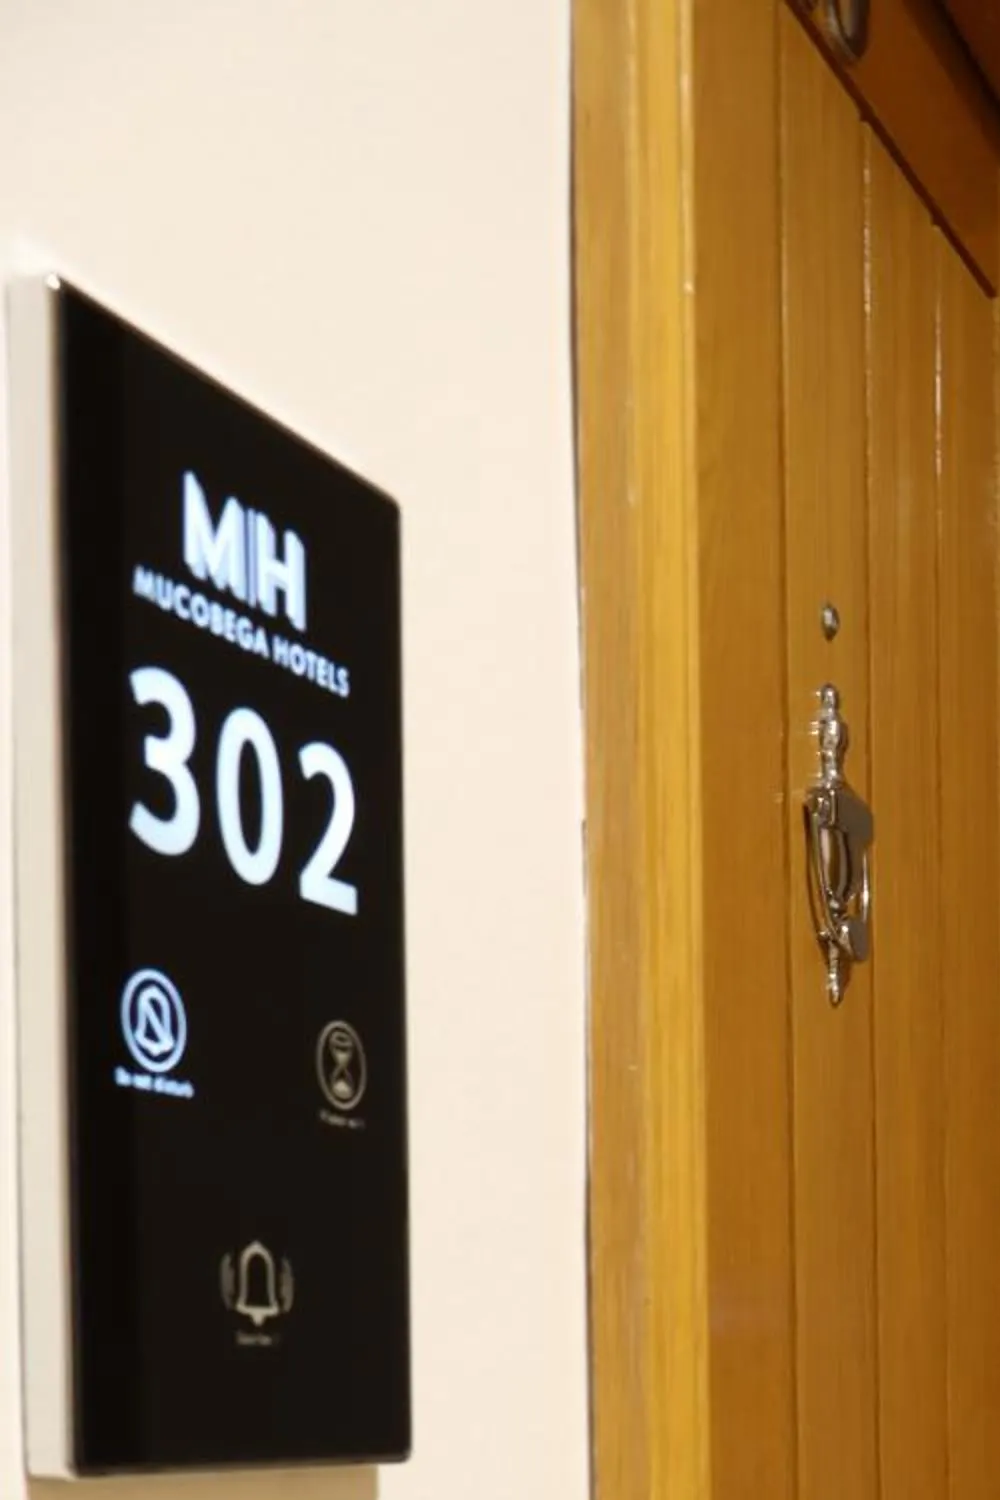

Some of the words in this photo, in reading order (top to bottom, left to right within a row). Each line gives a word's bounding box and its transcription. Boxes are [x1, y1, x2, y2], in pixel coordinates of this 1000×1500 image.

[132, 563, 270, 660] MUCOBEGA
[272, 634, 350, 698] HOTELS
[128, 665, 358, 916] 302
